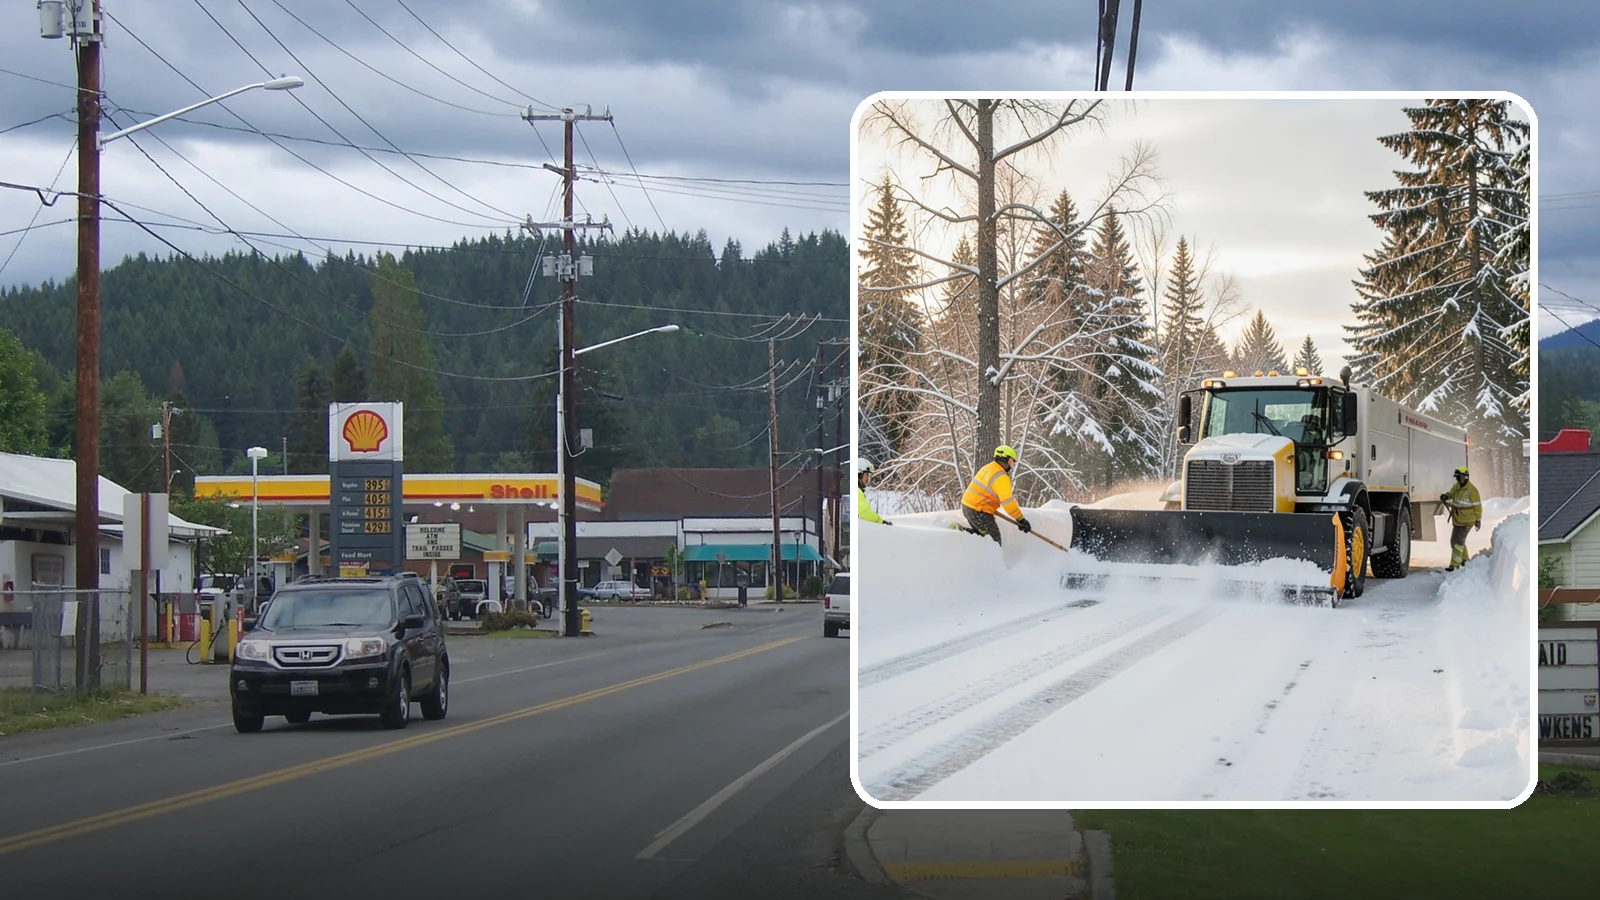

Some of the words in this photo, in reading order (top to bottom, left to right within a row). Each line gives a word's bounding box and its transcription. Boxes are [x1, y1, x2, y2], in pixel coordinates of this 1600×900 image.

[365, 480, 384, 490] 395
[490, 484, 547, 499] Shell
[365, 494, 384, 504] 405
[365, 508, 384, 518] 415
[365, 522, 384, 533] 429
[1538, 643, 1567, 665] AID
